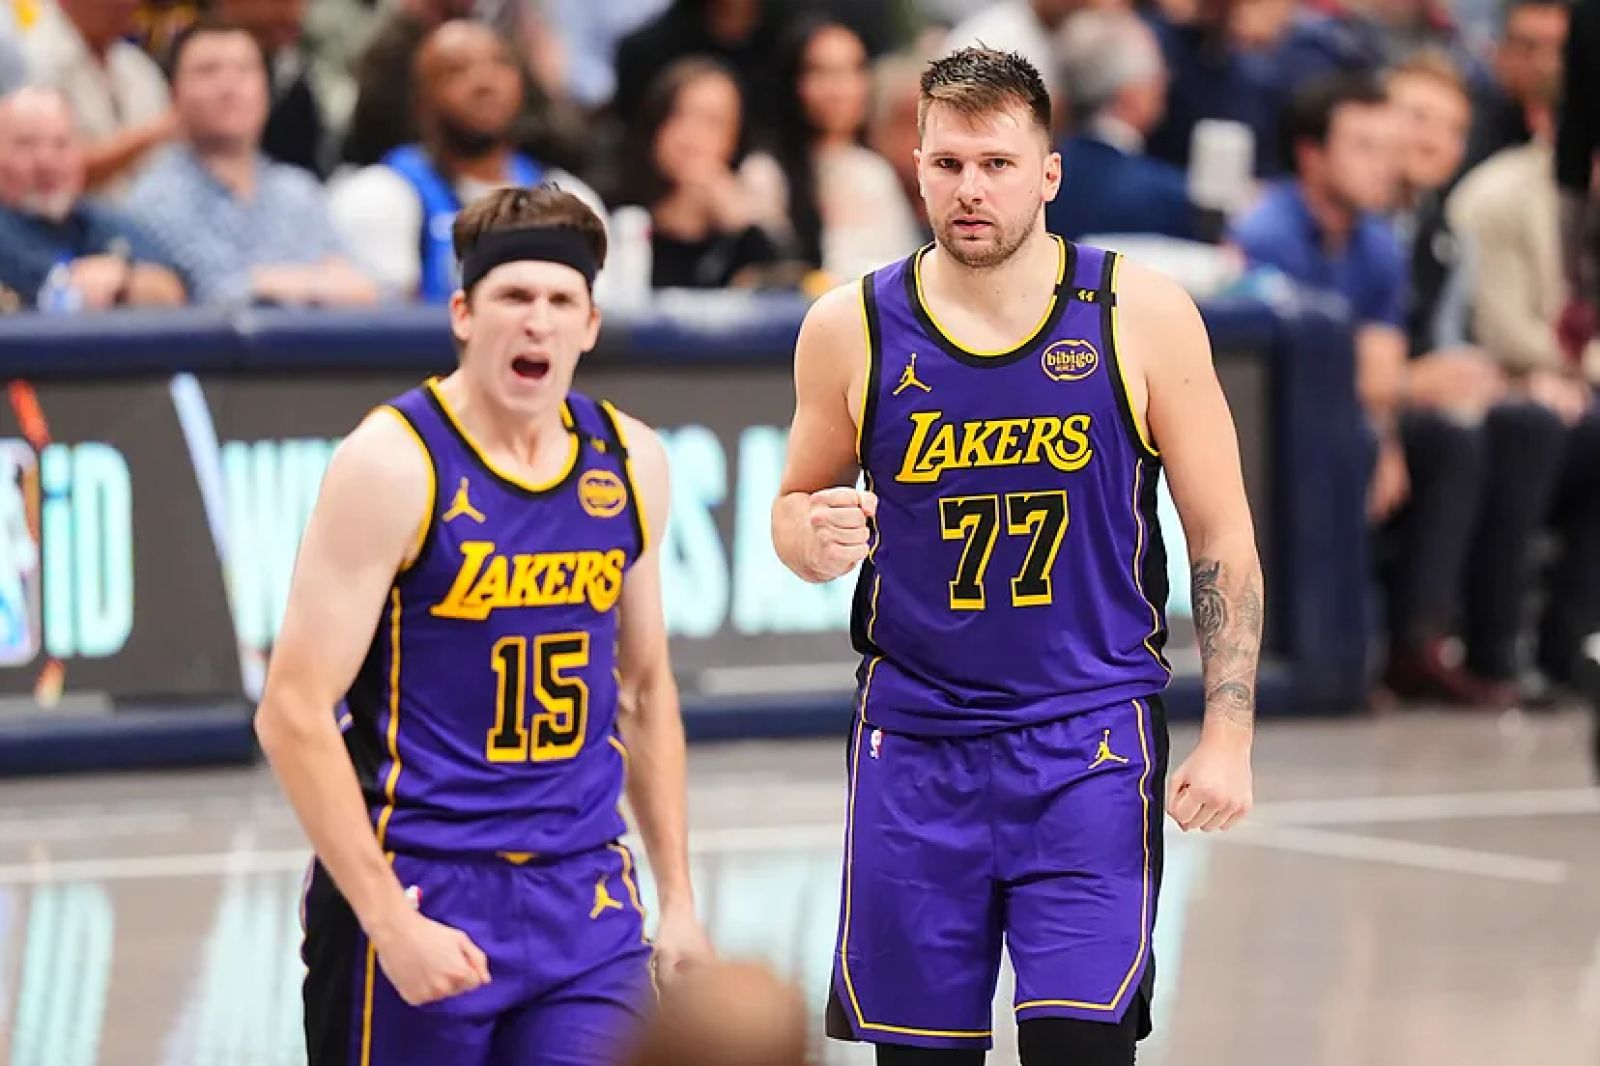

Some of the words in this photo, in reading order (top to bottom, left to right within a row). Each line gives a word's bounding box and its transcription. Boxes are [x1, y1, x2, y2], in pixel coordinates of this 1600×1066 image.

[1046, 350, 1095, 368] bibigo
[895, 411, 1093, 482] LAKERS
[430, 541, 626, 620] LAKERS
[938, 490, 1069, 611] 77
[486, 633, 590, 762] 15
